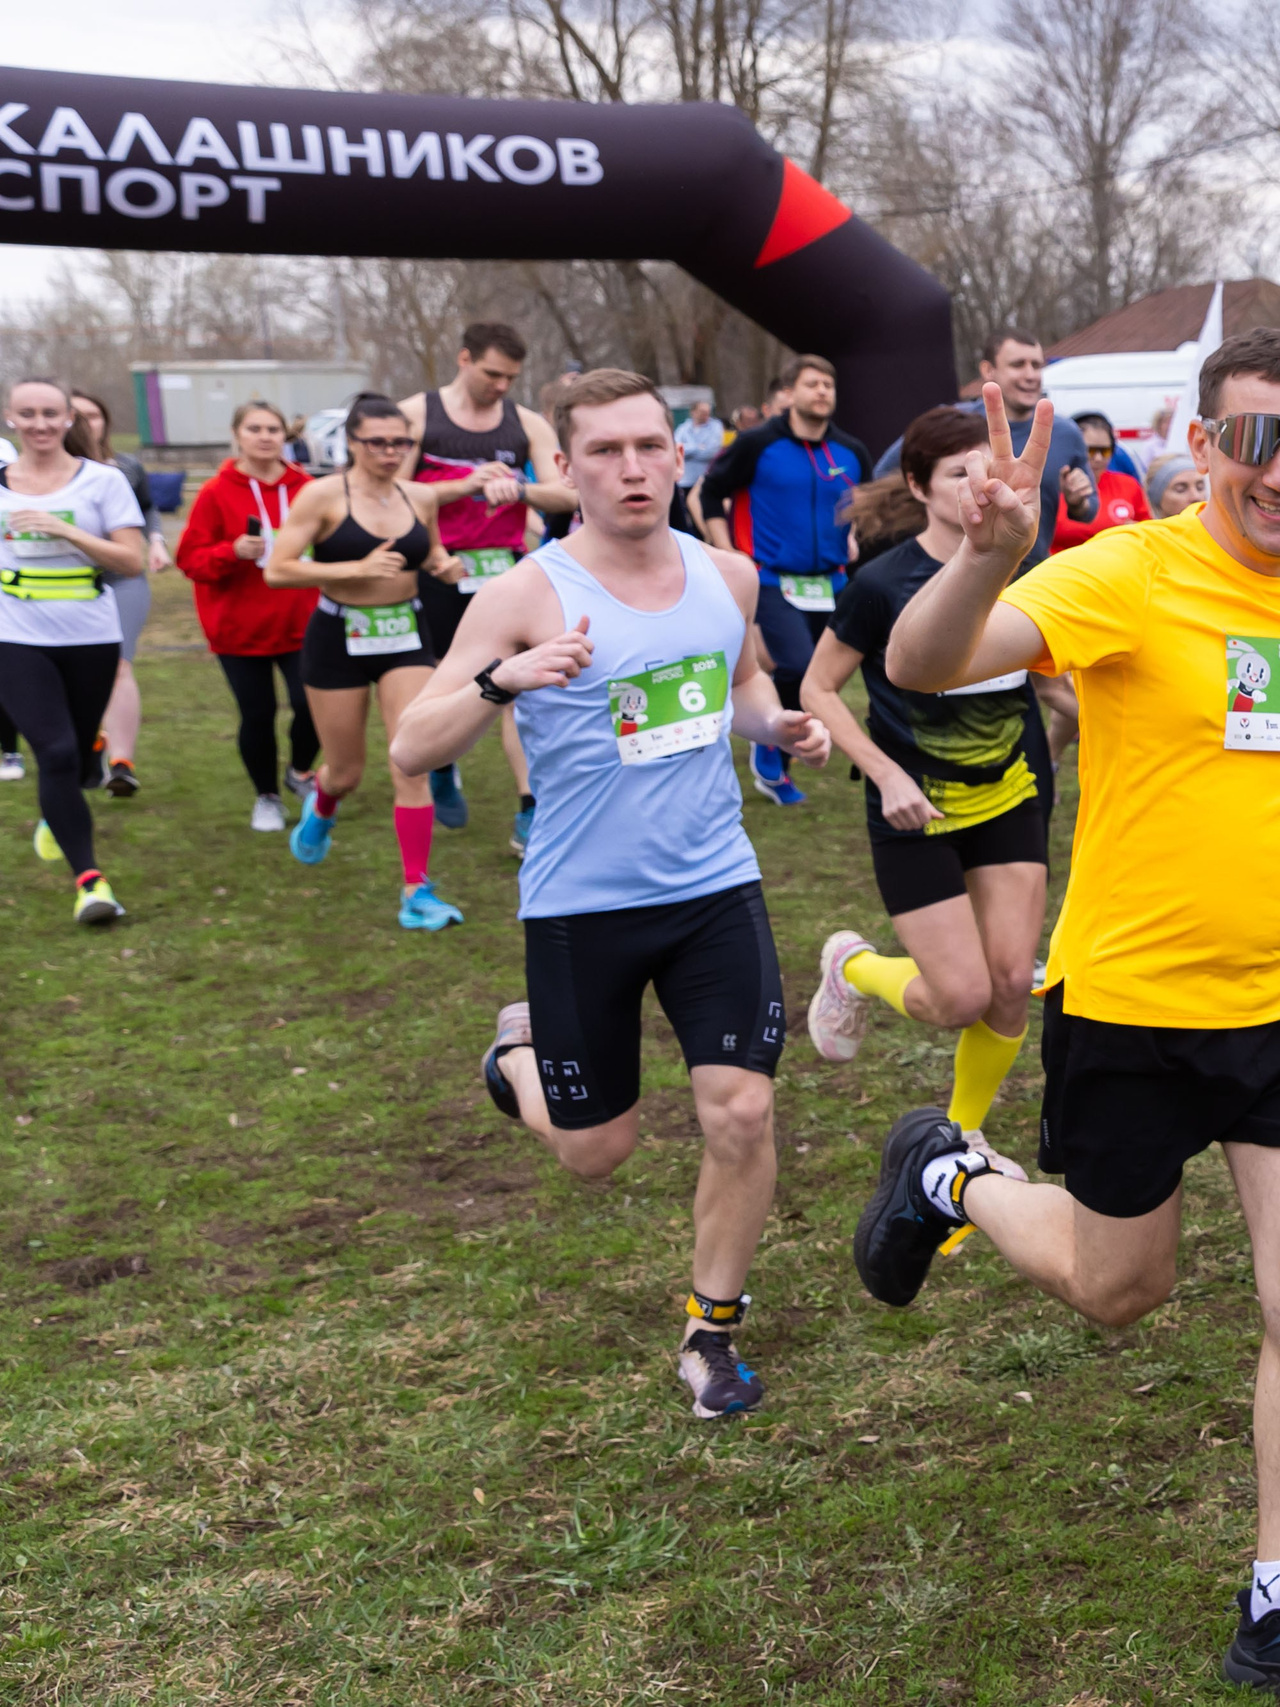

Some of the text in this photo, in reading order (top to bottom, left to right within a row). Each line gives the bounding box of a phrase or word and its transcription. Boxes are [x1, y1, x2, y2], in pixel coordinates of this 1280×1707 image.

[0, 102, 604, 186] КАЛАШНИКОВ
[0, 158, 281, 224] СПОРТ
[374, 615, 411, 636] 109
[678, 681, 707, 713] 6
